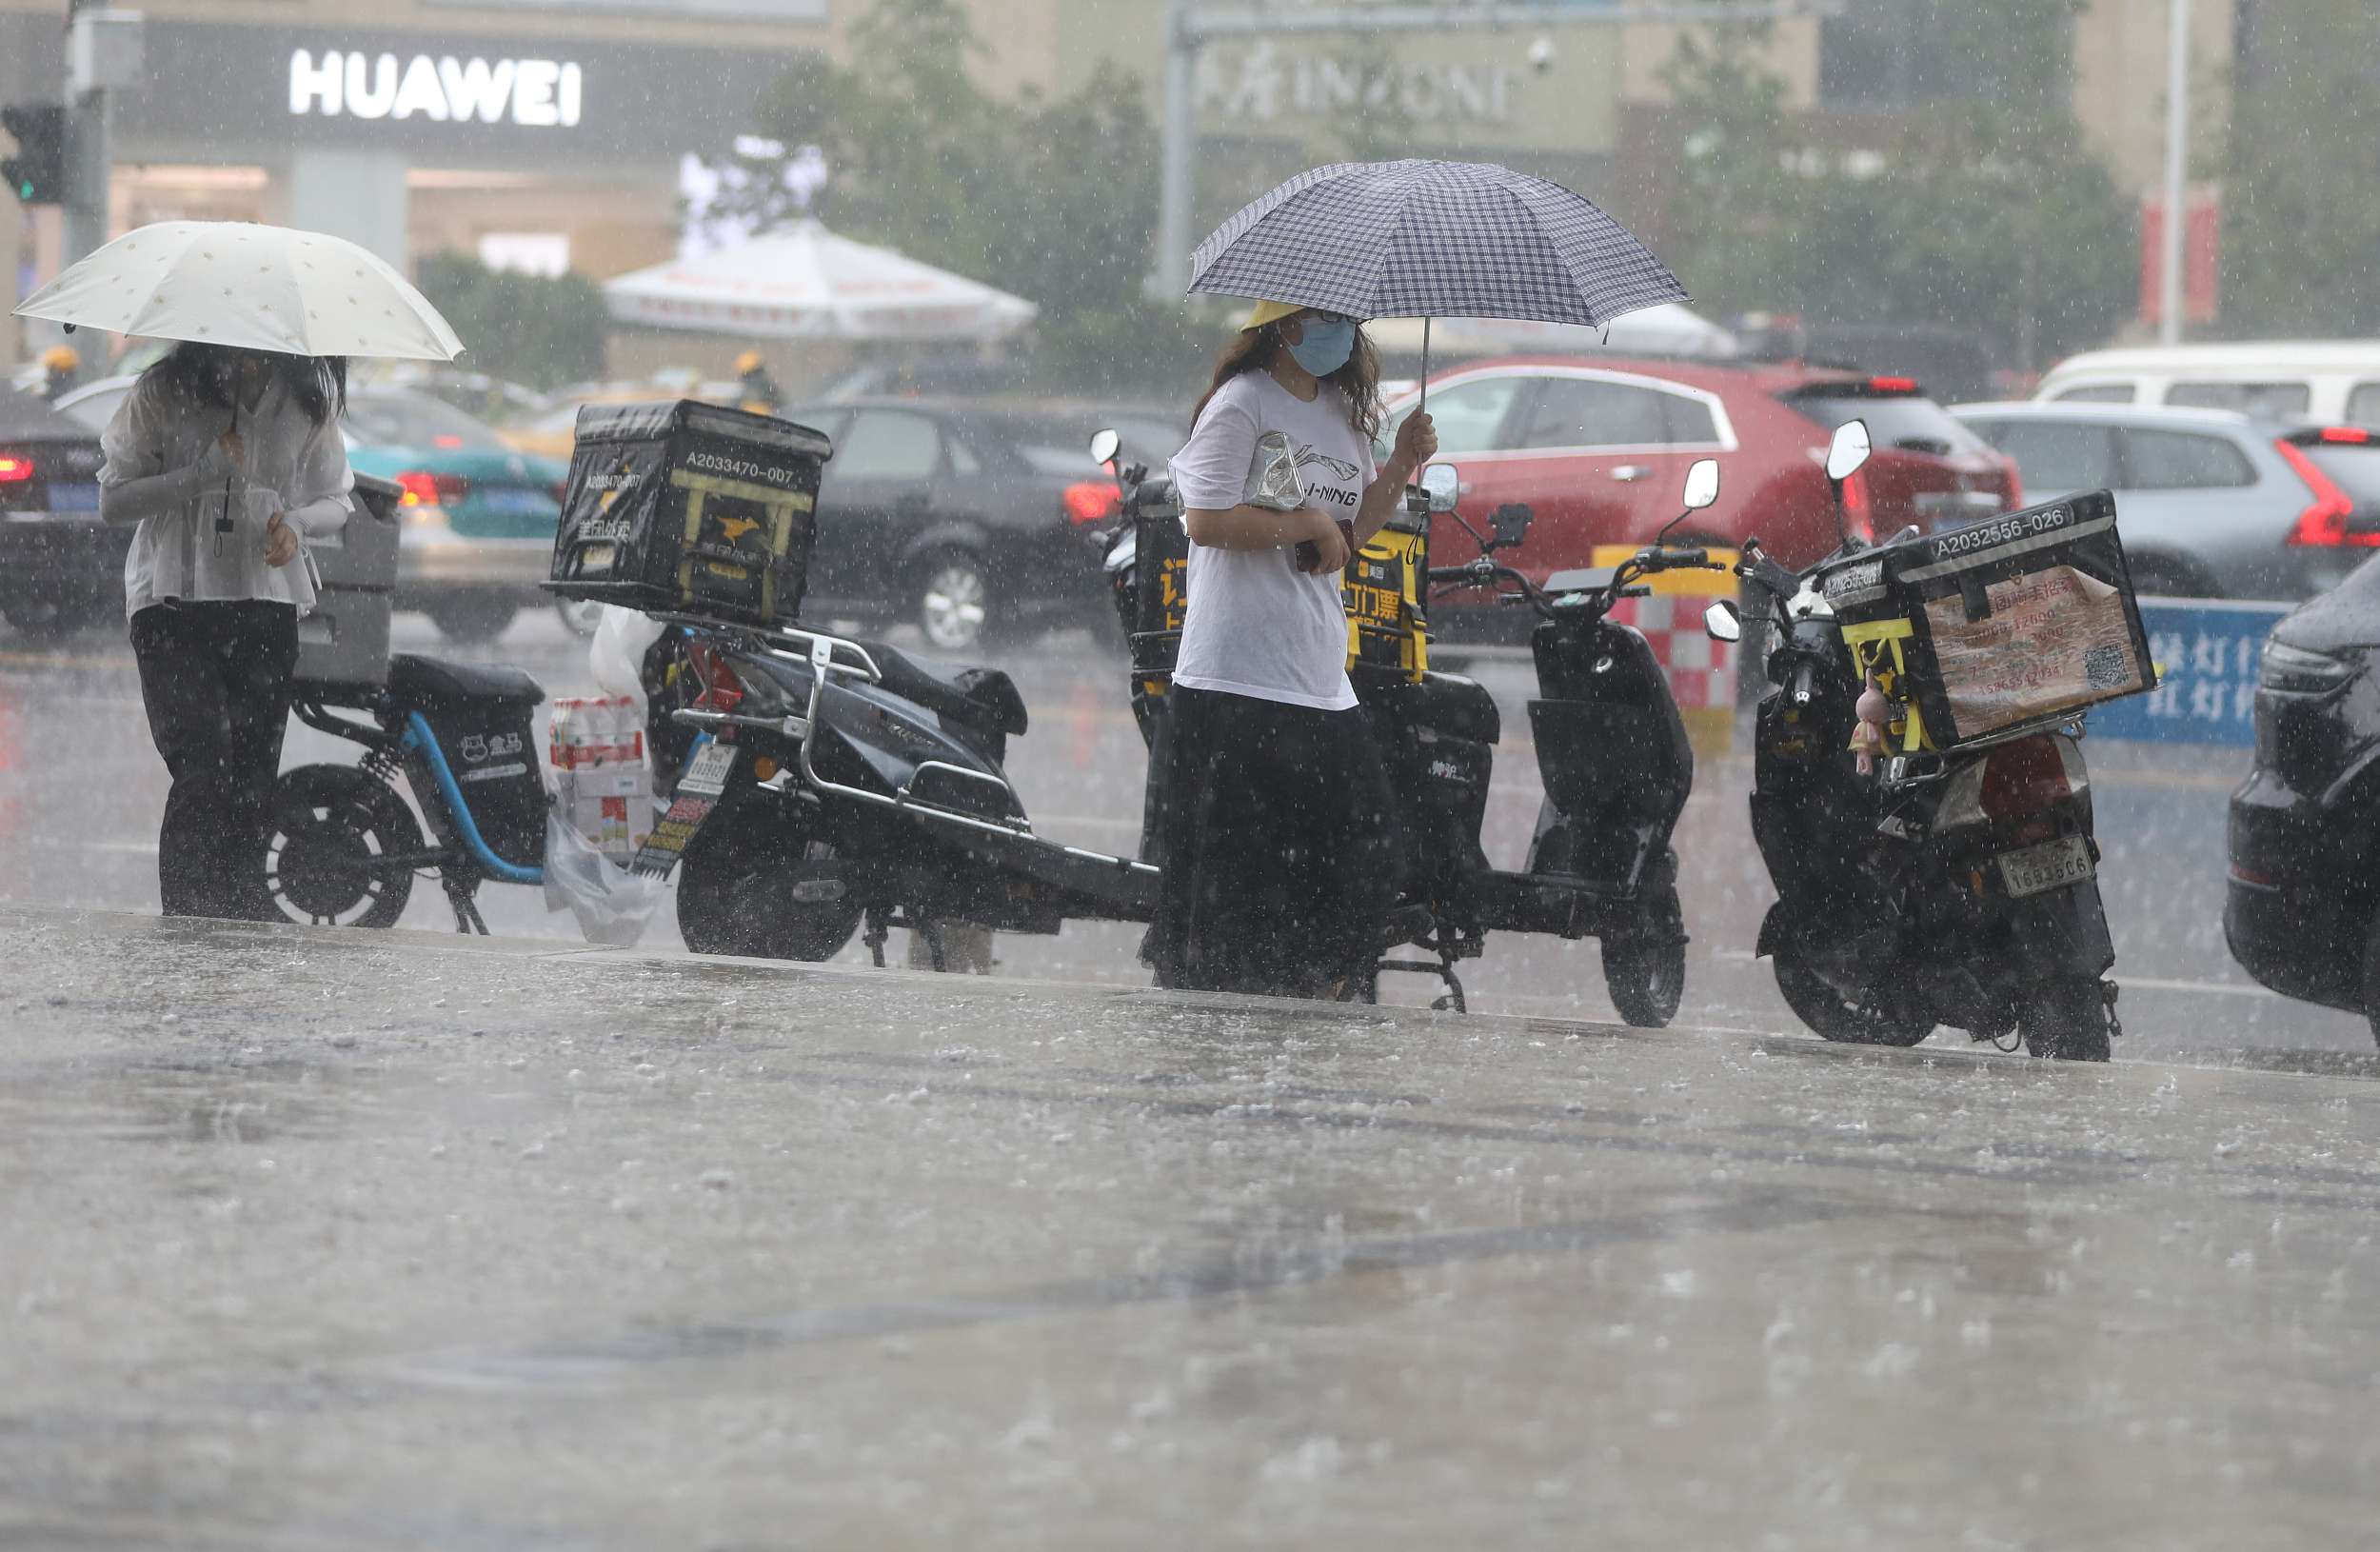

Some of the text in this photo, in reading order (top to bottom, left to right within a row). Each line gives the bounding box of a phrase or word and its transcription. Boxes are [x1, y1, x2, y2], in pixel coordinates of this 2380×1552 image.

[289, 49, 582, 127] HUAWEI
[686, 451, 795, 484] A2033470-007
[1304, 483, 1358, 507] I-NING
[1938, 508, 2065, 557] A2032556-026
